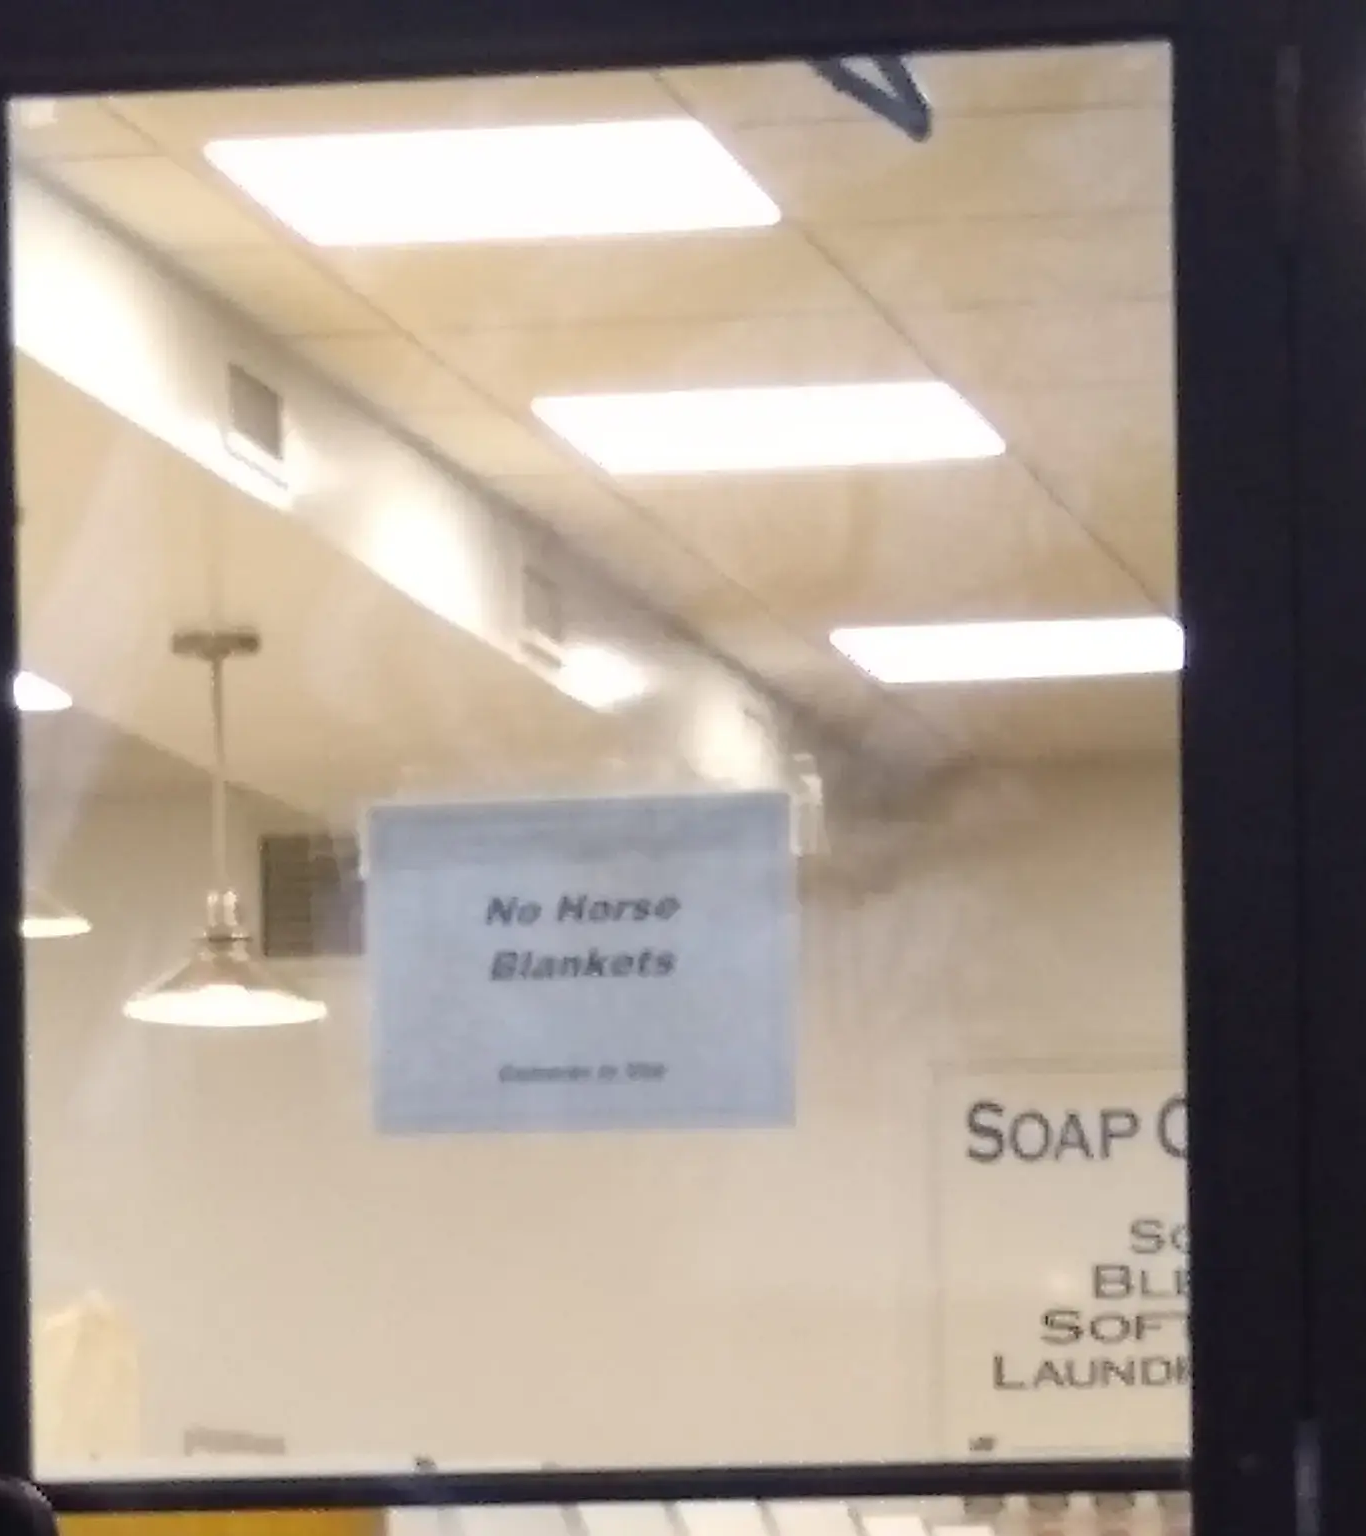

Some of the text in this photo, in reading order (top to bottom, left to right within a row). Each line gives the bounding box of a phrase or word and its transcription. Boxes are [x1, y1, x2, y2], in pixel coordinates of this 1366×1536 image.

[485, 893, 681, 927] No Horse
[490, 948, 677, 981] Blankets
[966, 1099, 1141, 1162] SOAP
